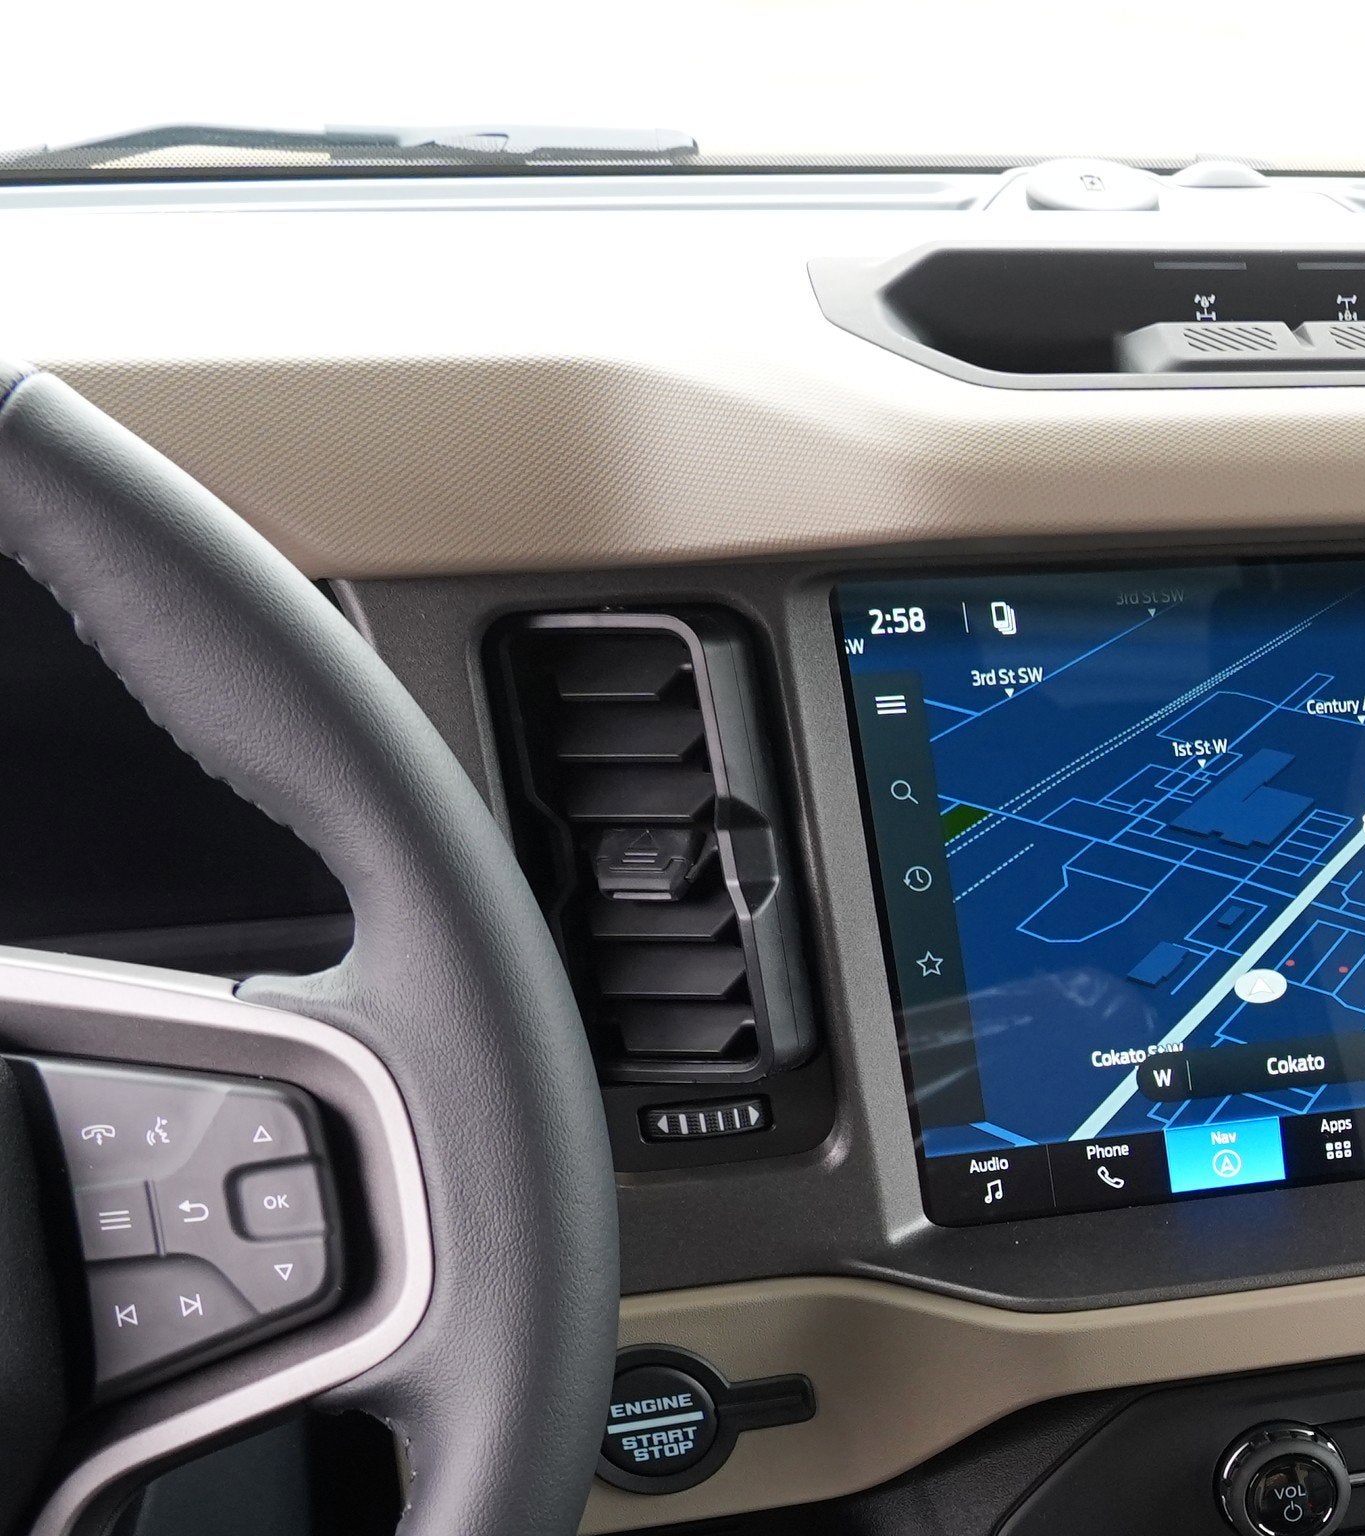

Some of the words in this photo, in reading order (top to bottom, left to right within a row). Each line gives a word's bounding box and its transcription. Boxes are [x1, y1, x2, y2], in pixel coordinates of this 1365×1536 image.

[868, 606, 926, 635] 2:58
[970, 668, 996, 688] 3rd
[998, 668, 1017, 686] St
[1018, 666, 1044, 685] SW
[1306, 699, 1359, 717] Century
[1172, 741, 1195, 758] 1st
[1195, 740, 1212, 756] St
[1212, 738, 1229, 755] W
[1091, 1048, 1147, 1068] Cokato
[1152, 1068, 1172, 1088] W
[1266, 1053, 1326, 1077] Cokato
[1320, 1117, 1352, 1136] Apps
[1210, 1130, 1237, 1145] Nav
[1086, 1142, 1130, 1161] Phone
[969, 1156, 1009, 1173] Audio
[262, 1194, 290, 1210] OK
[609, 1392, 694, 1419] ENGINE
[621, 1426, 698, 1451] START
[633, 1440, 694, 1463] STOP
[1274, 1484, 1306, 1500] VOL
